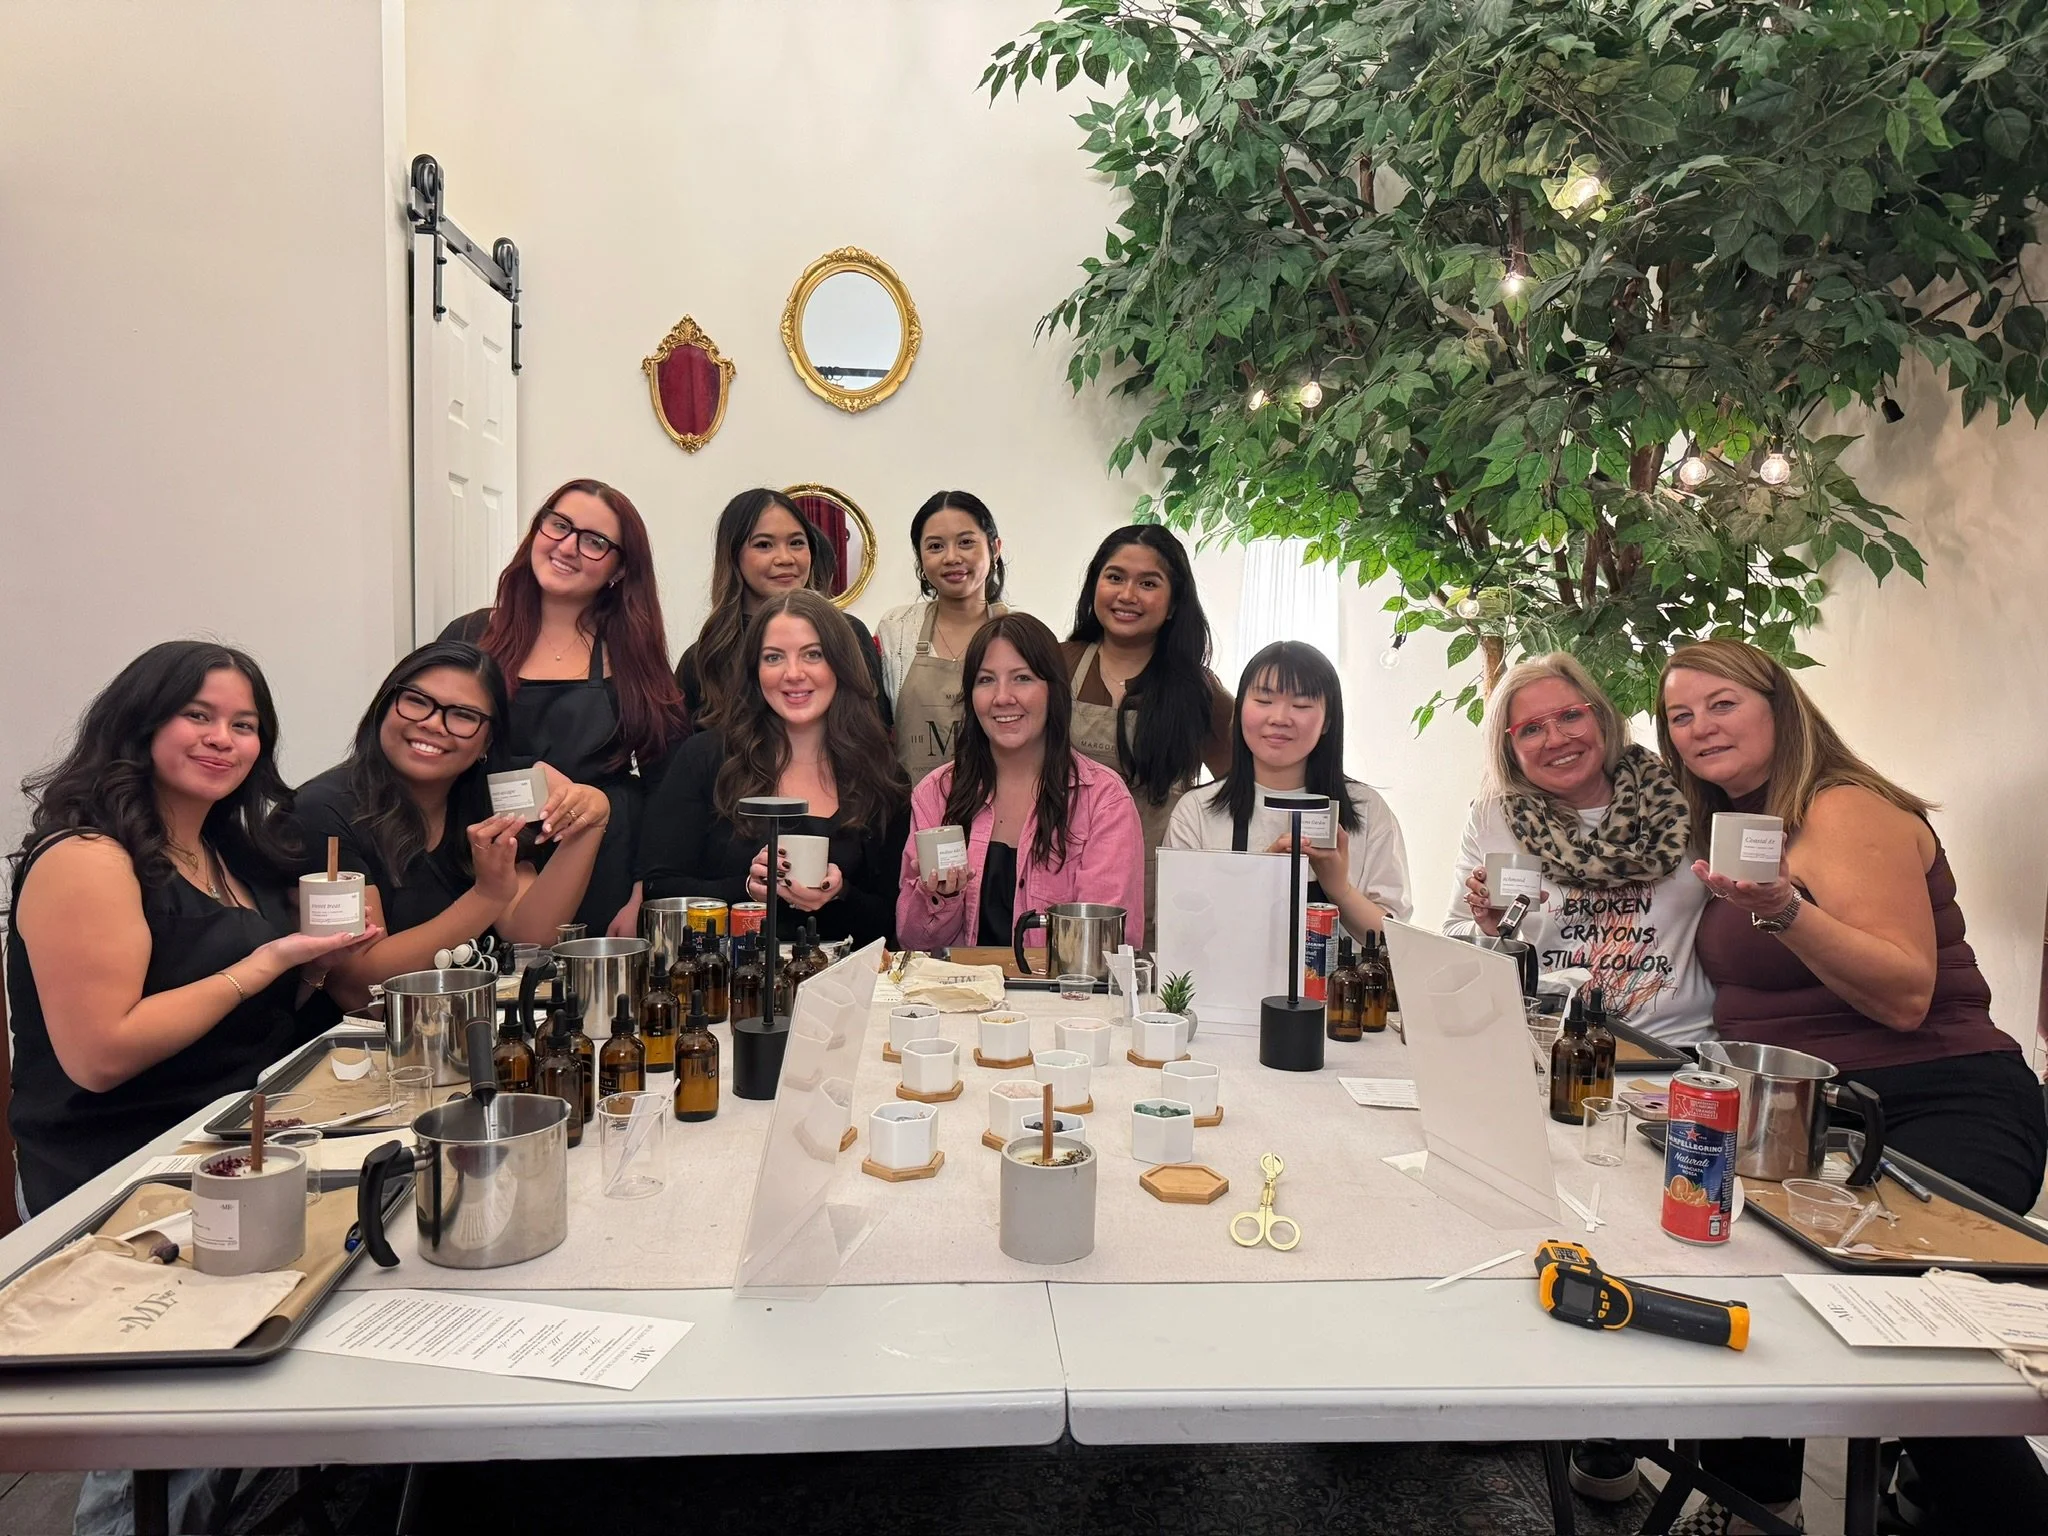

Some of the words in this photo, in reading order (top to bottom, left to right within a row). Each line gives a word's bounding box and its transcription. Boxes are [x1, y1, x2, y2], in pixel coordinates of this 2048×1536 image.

[1563, 897, 1652, 916] BROKEN
[1560, 924, 1656, 944] CRAYONS
[1541, 949, 1593, 969] STILL
[1599, 953, 1673, 975] COLOR.
[1674, 1151, 1710, 1168] Naturali
